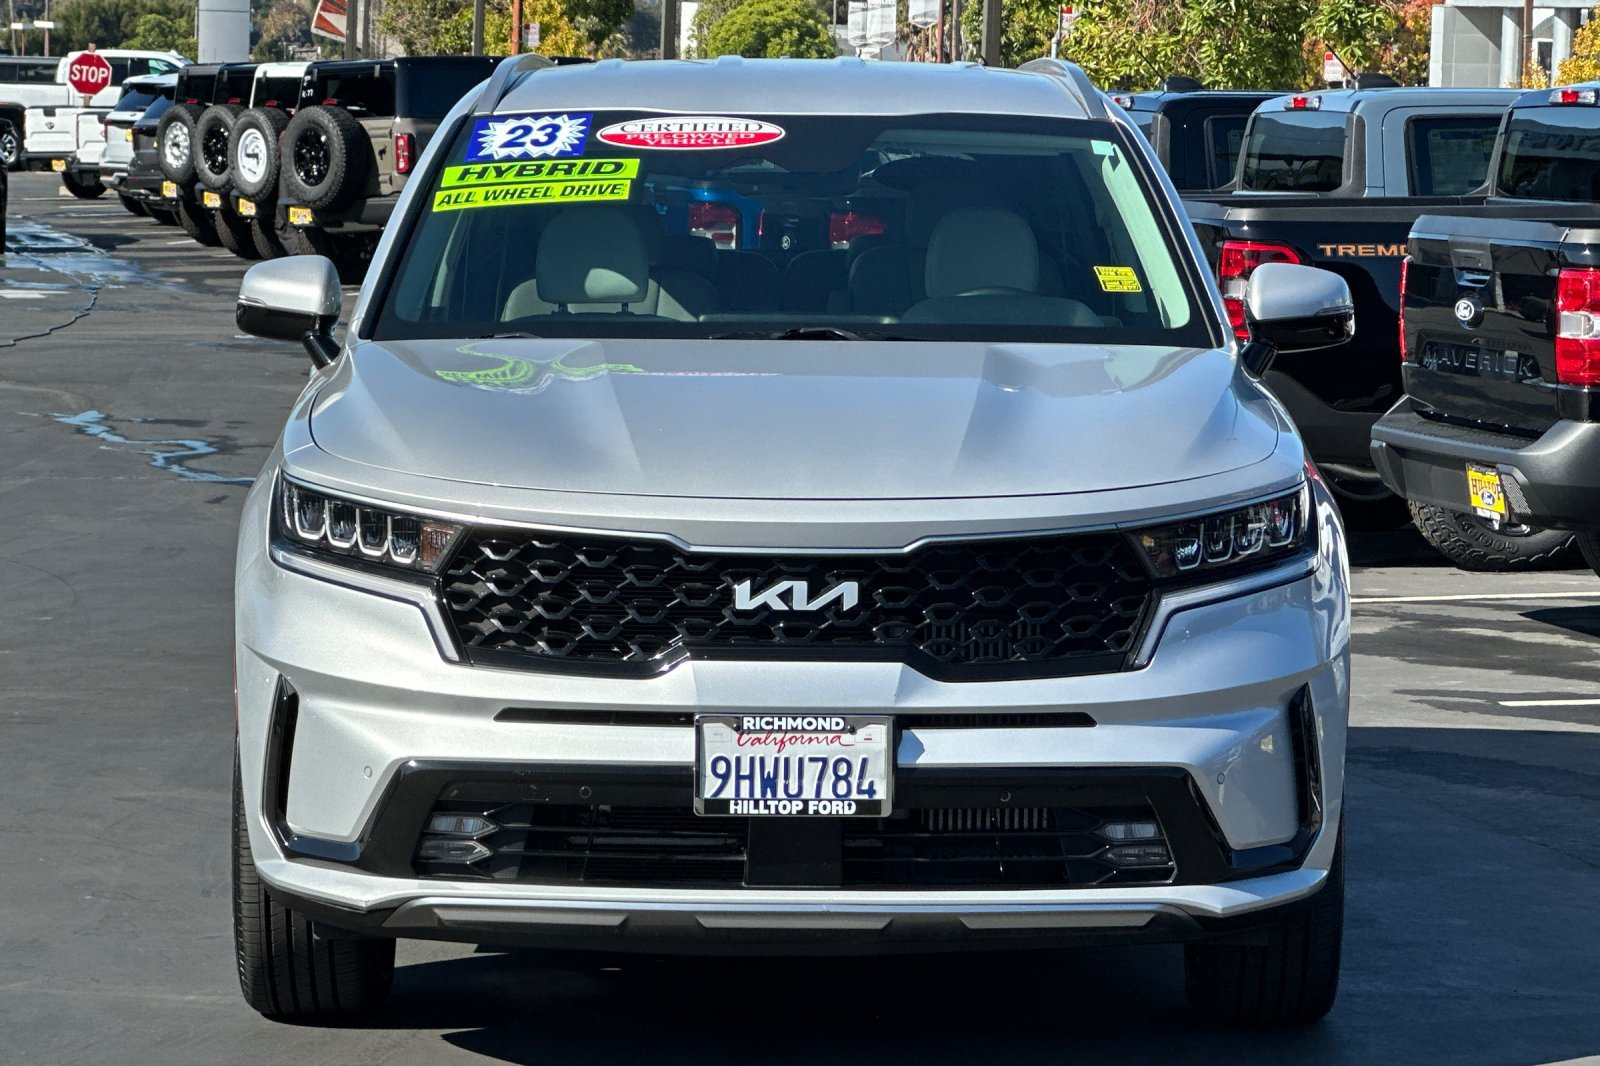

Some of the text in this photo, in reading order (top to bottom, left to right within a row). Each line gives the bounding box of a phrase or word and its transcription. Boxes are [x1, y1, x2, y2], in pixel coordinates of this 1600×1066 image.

[71, 64, 108, 83] STOP
[498, 123, 563, 149] 23
[620, 122, 763, 132] CERTIFIED
[625, 132, 756, 140] PRE-OWNED
[456, 161, 627, 182] HYBRID
[437, 183, 626, 207] ALL WHEEL DRIVE
[1423, 345, 1535, 378] MAVERICK
[735, 580, 859, 611] KIA
[743, 717, 845, 731] RICHMOND
[737, 730, 855, 753] California
[710, 756, 877, 799] 9HWU784
[730, 800, 857, 815] HILLTOP FORD
